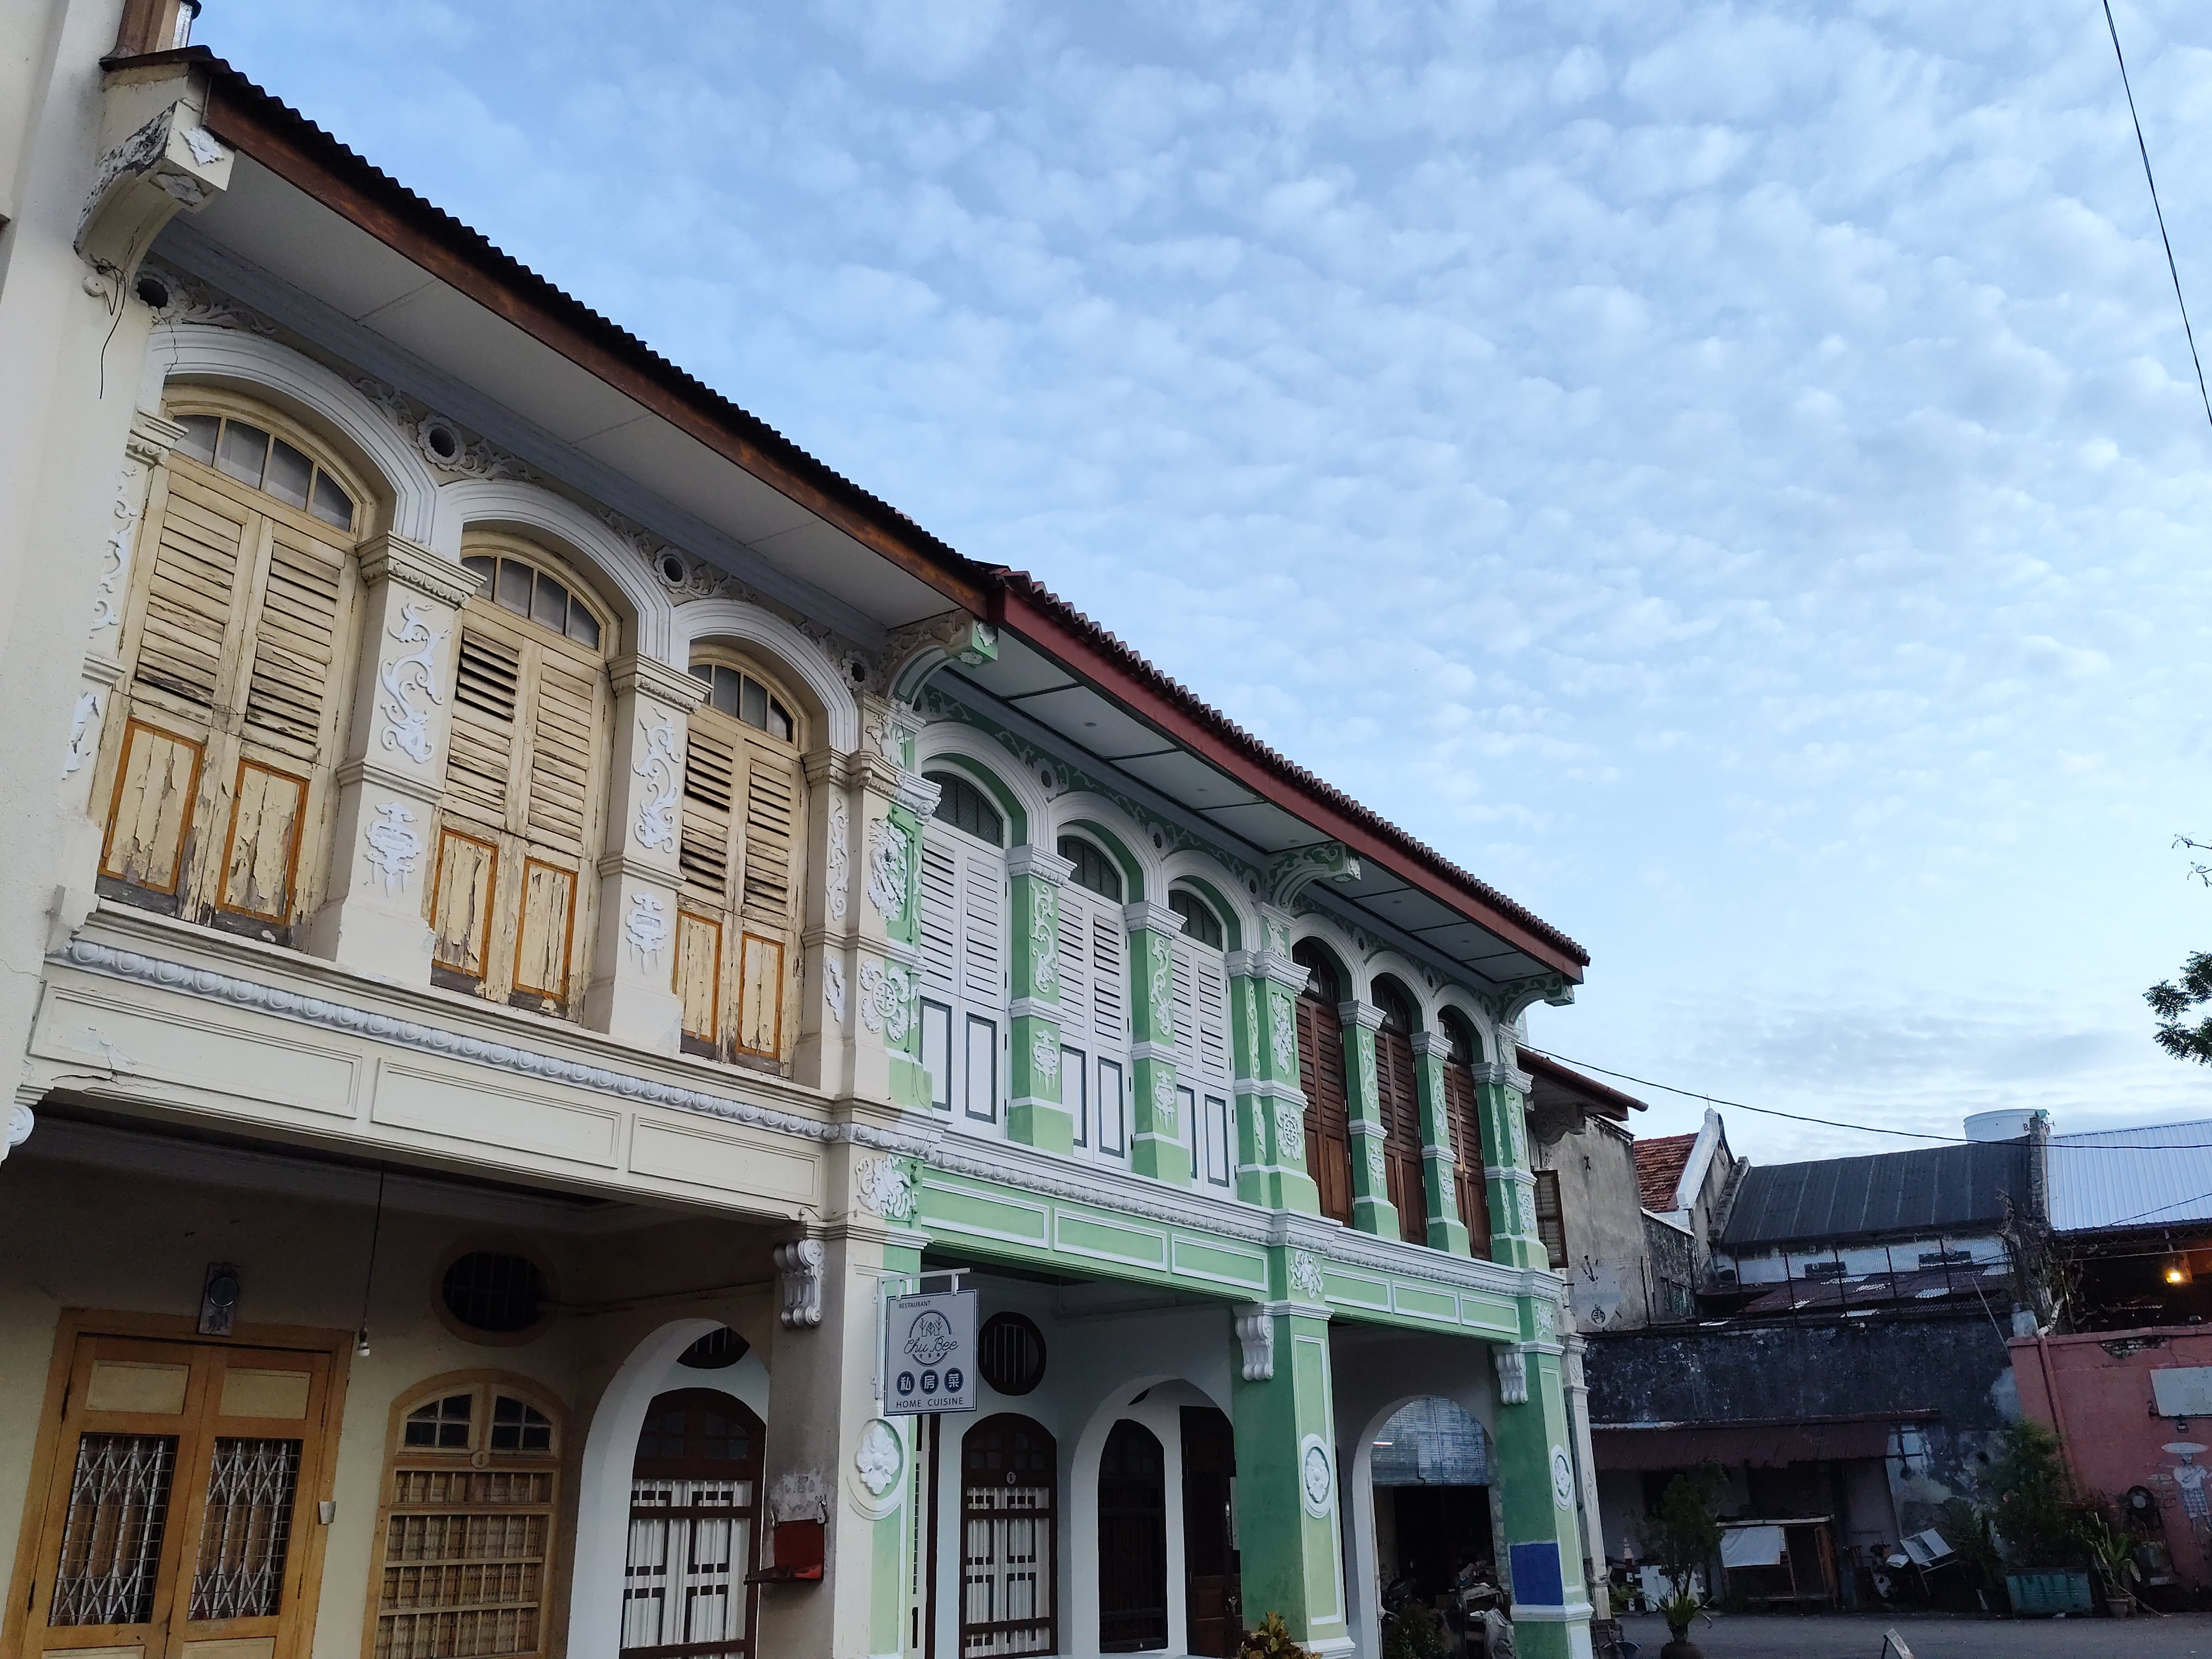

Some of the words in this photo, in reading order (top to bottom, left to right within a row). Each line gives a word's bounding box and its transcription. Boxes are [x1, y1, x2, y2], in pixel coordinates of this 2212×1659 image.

[899, 1300, 931, 1309] RESTAURANT
[904, 1337, 929, 1354] Chu
[930, 1335, 959, 1352] Bee
[900, 1373, 960, 1391] 私房菜
[896, 1399, 922, 1409] HOME
[928, 1397, 963, 1407] CUISINE
